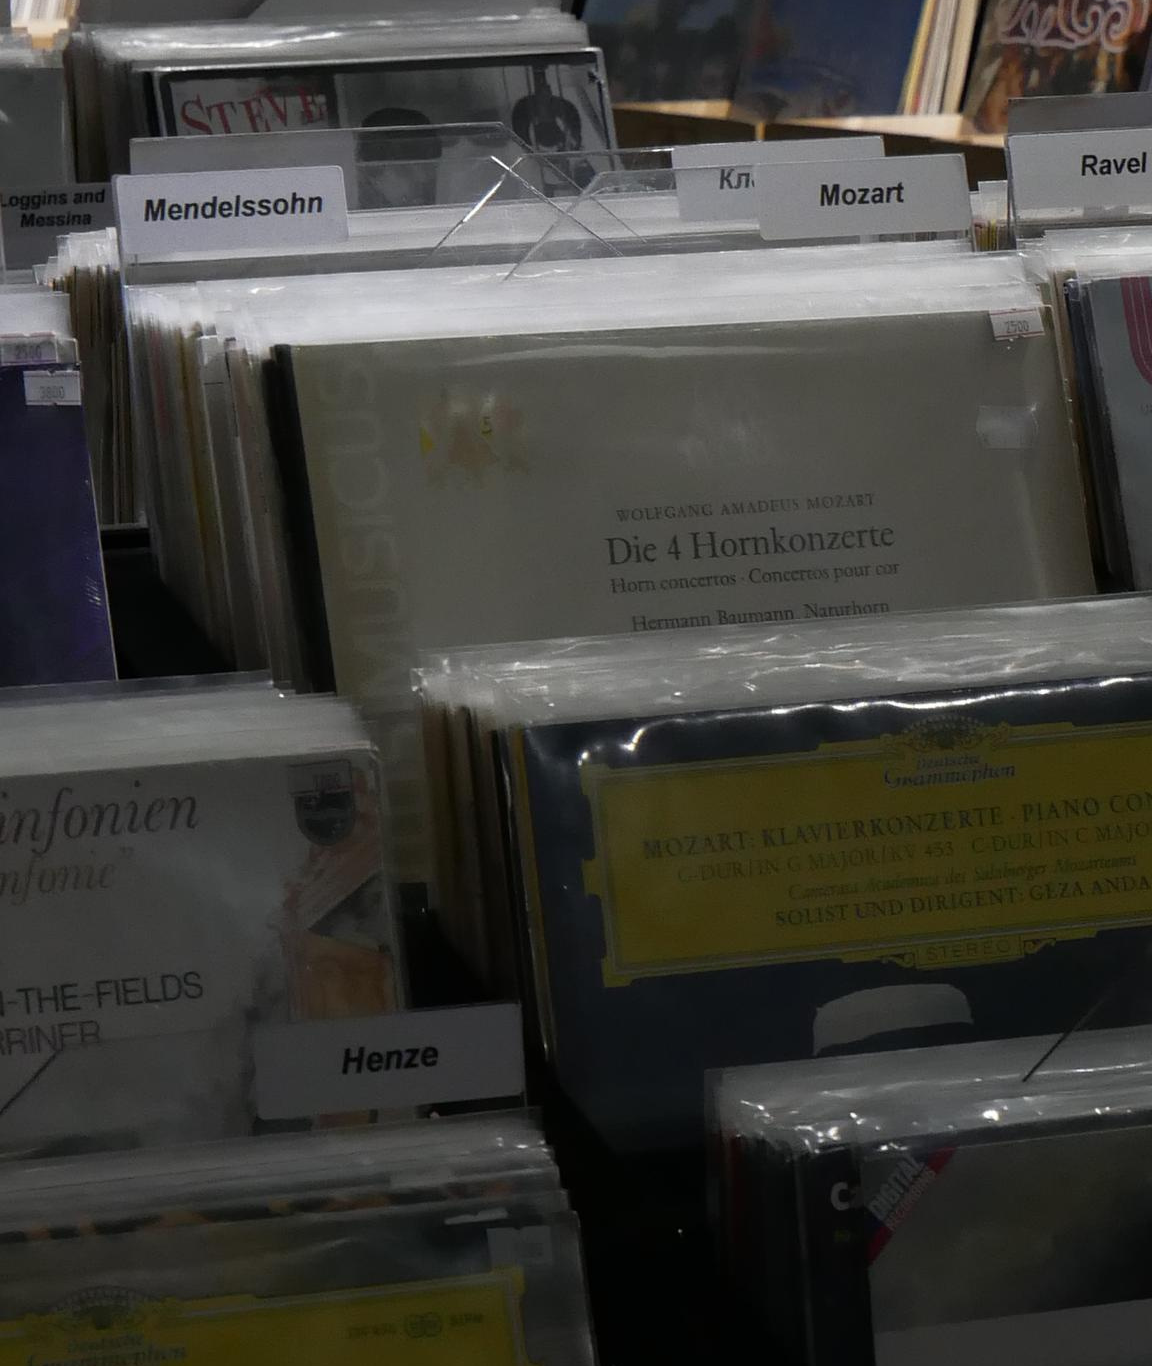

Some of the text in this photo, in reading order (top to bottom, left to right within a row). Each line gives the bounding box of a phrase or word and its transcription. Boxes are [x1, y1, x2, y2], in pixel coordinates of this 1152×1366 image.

[180, 85, 330, 135] STEVE
[1080, 151, 1147, 177] Ravel
[73, 189, 105, 204] and
[143, 192, 324, 223] Mendelssohn
[818, 181, 905, 207] Mozart
[20, 211, 92, 228] Messina
[616, 493, 875, 523] WOLFGANG AMADEUS MOZART
[605, 526, 895, 565] Die 4 Hornkonzerte
[610, 578, 656, 595] Horn
[660, 572, 737, 590] concertos
[748, 567, 830, 585] Concertos
[833, 564, 871, 583] pour
[631, 614, 711, 632] Hermann
[642, 830, 755, 860] MOZART:
[761, 805, 1003, 848] KLAVIERKONZERTE
[1022, 796, 1101, 823] PIANO
[775, 904, 848, 928] SOLIST
[855, 897, 903, 920] UND
[911, 887, 1024, 915] DIRIGENT:
[1091, 873, 1152, 896] ANDA
[341, 1043, 439, 1075] Henze
[868, 1154, 928, 1222] DIGITAL
